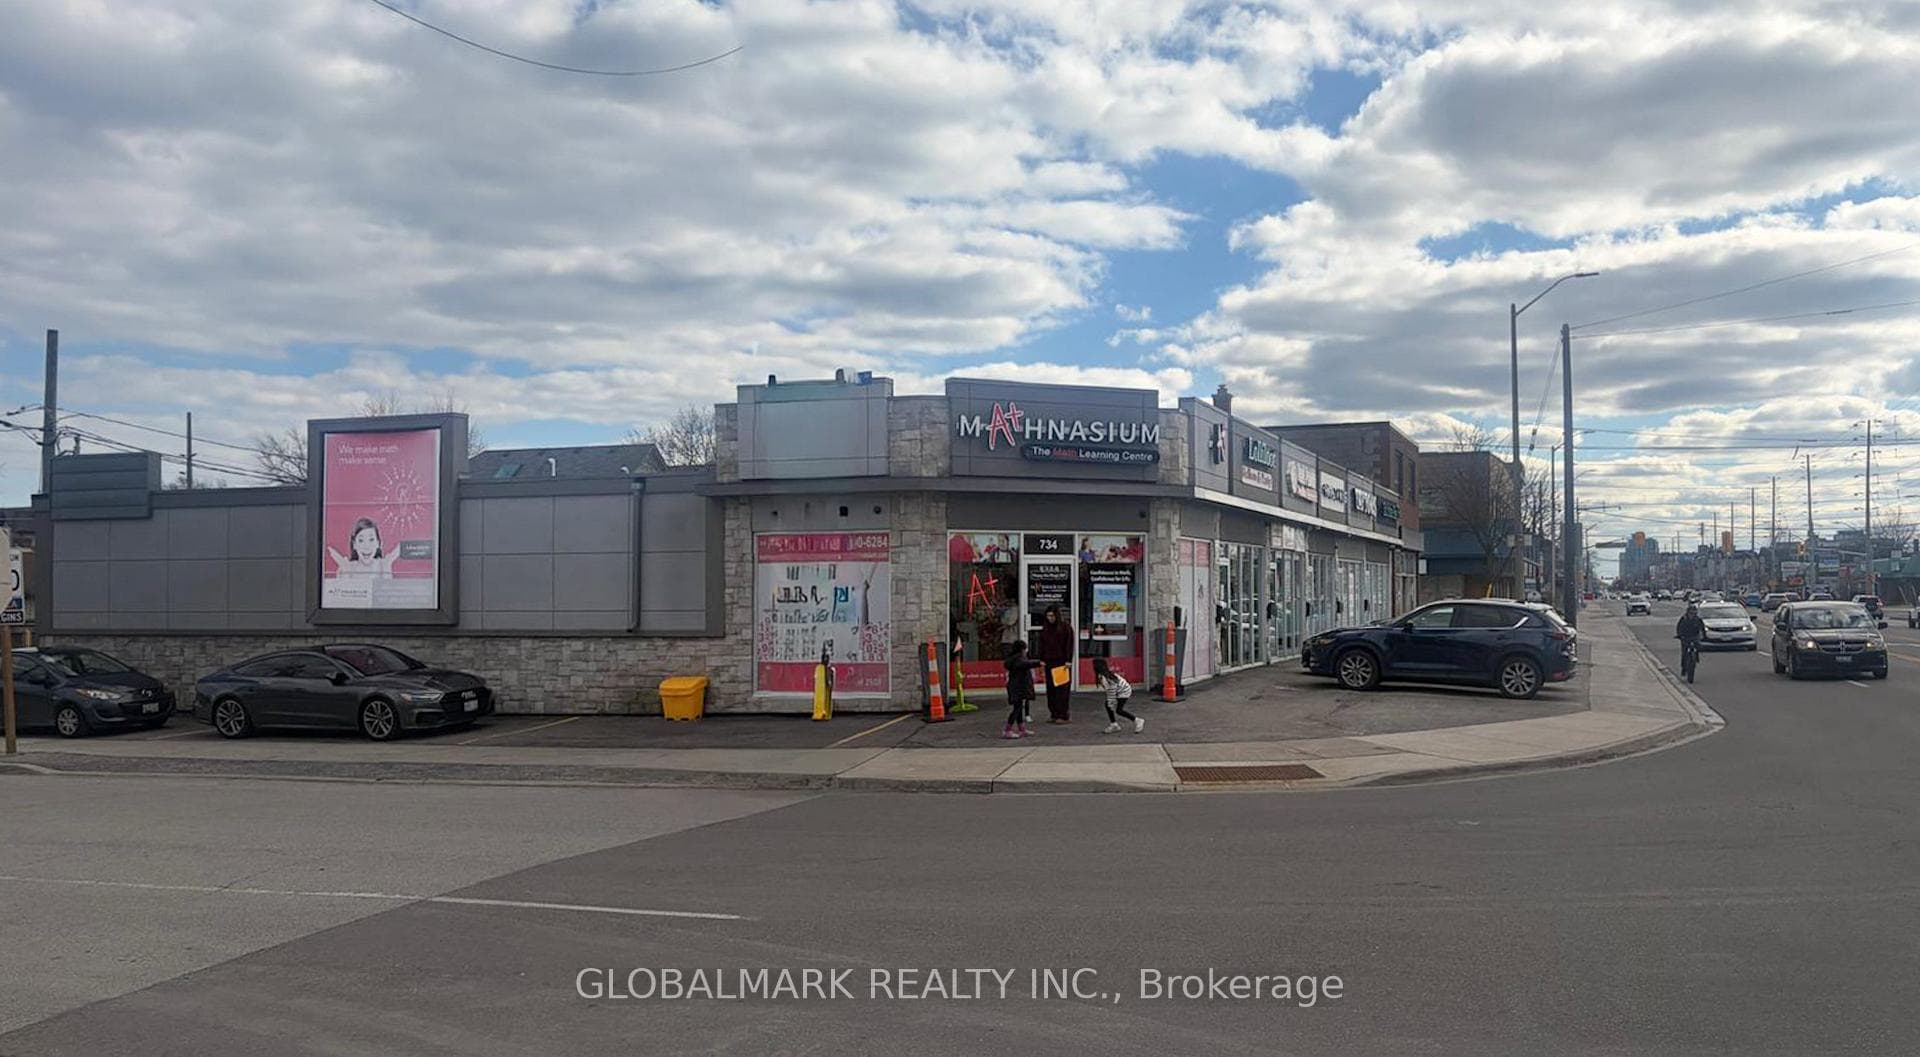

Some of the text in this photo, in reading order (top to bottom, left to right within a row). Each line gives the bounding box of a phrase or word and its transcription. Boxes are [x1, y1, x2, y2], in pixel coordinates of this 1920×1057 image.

[1032, 446, 1051, 456] The
[1079, 449, 1120, 462] Learning
[1122, 451, 1154, 462] Centre
[1039, 539, 1058, 550] 734
